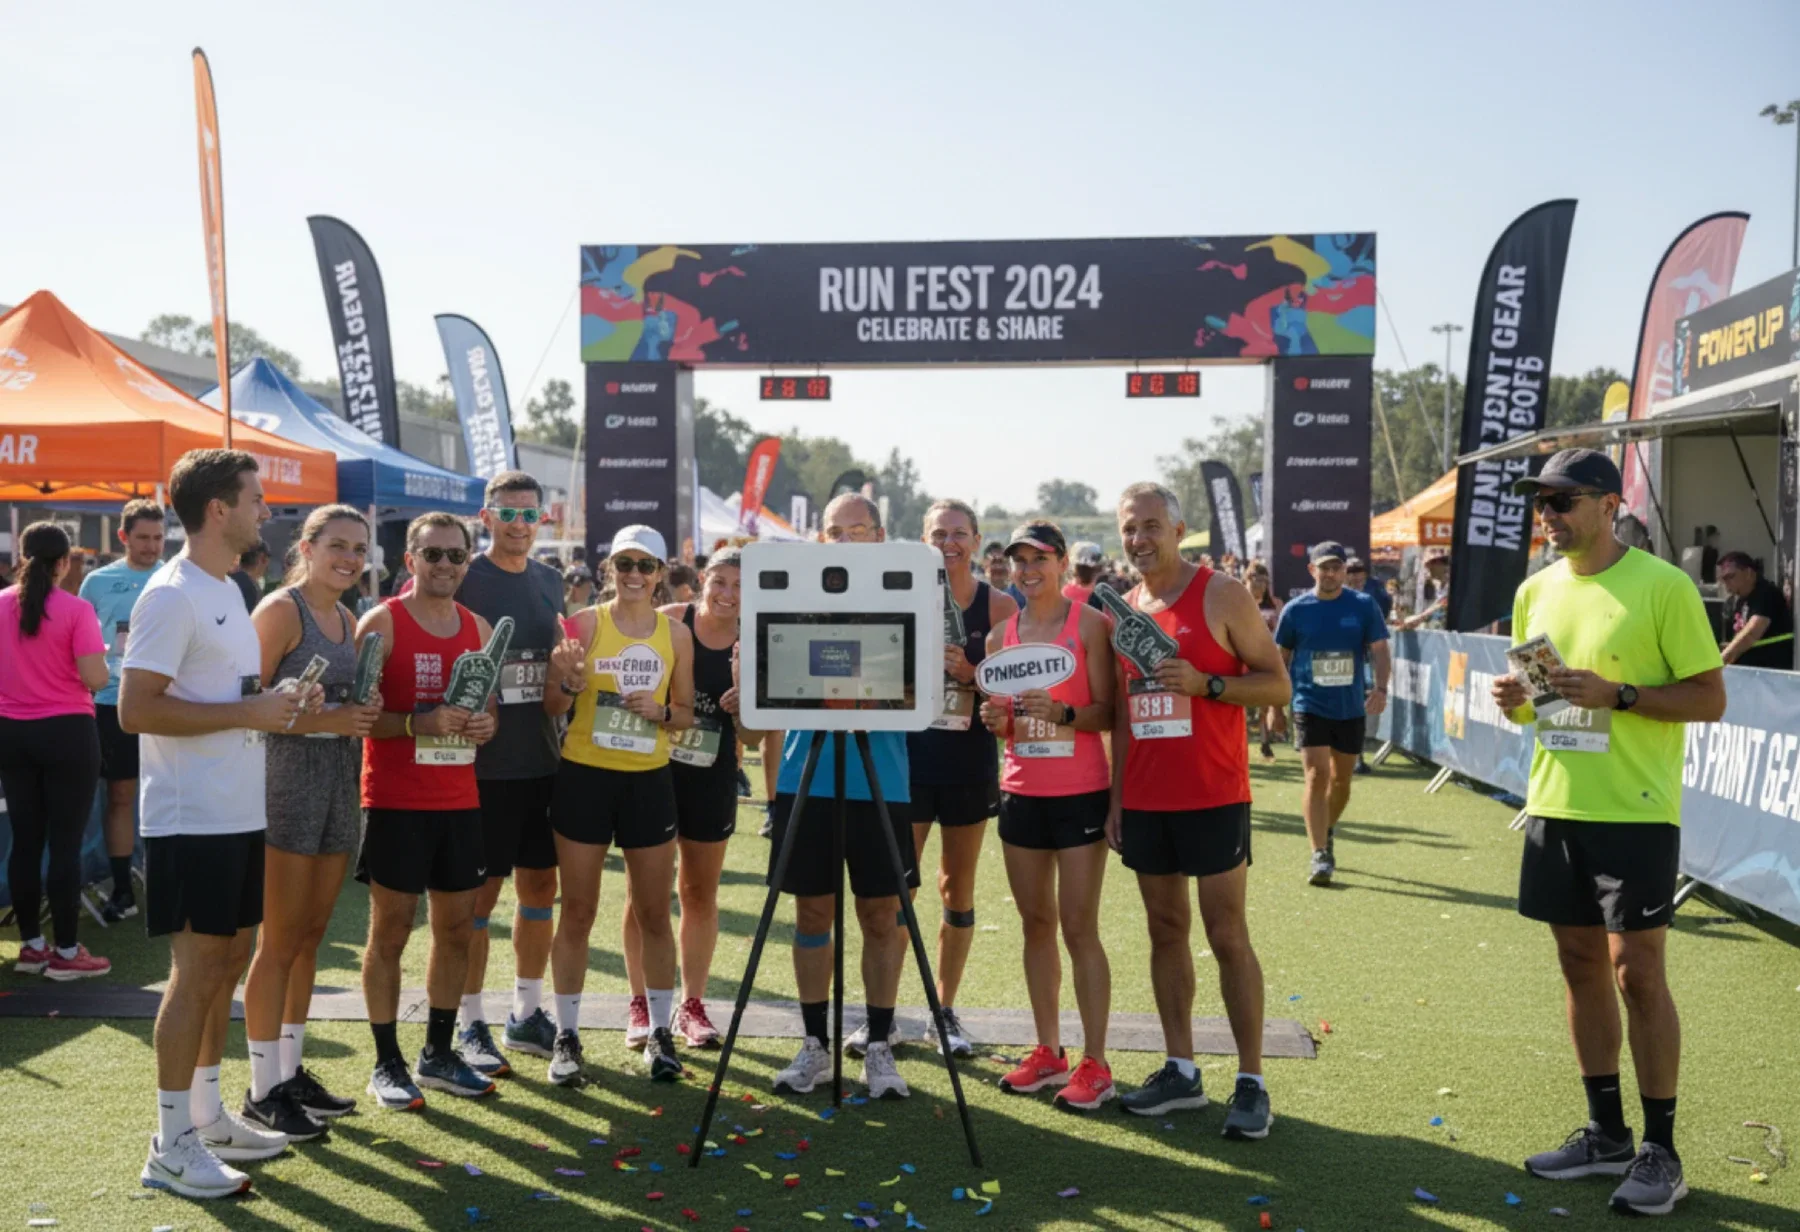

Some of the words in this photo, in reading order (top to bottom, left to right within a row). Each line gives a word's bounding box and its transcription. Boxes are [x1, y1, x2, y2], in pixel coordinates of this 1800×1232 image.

[819, 267, 895, 312] RUN
[906, 265, 995, 312] FEST
[1004, 264, 1103, 310] 2024
[1490, 264, 1527, 349] GEAR
[857, 316, 972, 341] CELEBRATE
[976, 317, 991, 340] &
[996, 315, 1064, 340] SHARE
[1697, 315, 1757, 369] POWER
[1758, 304, 1785, 350] UP
[1700, 722, 1767, 807] PRINT
